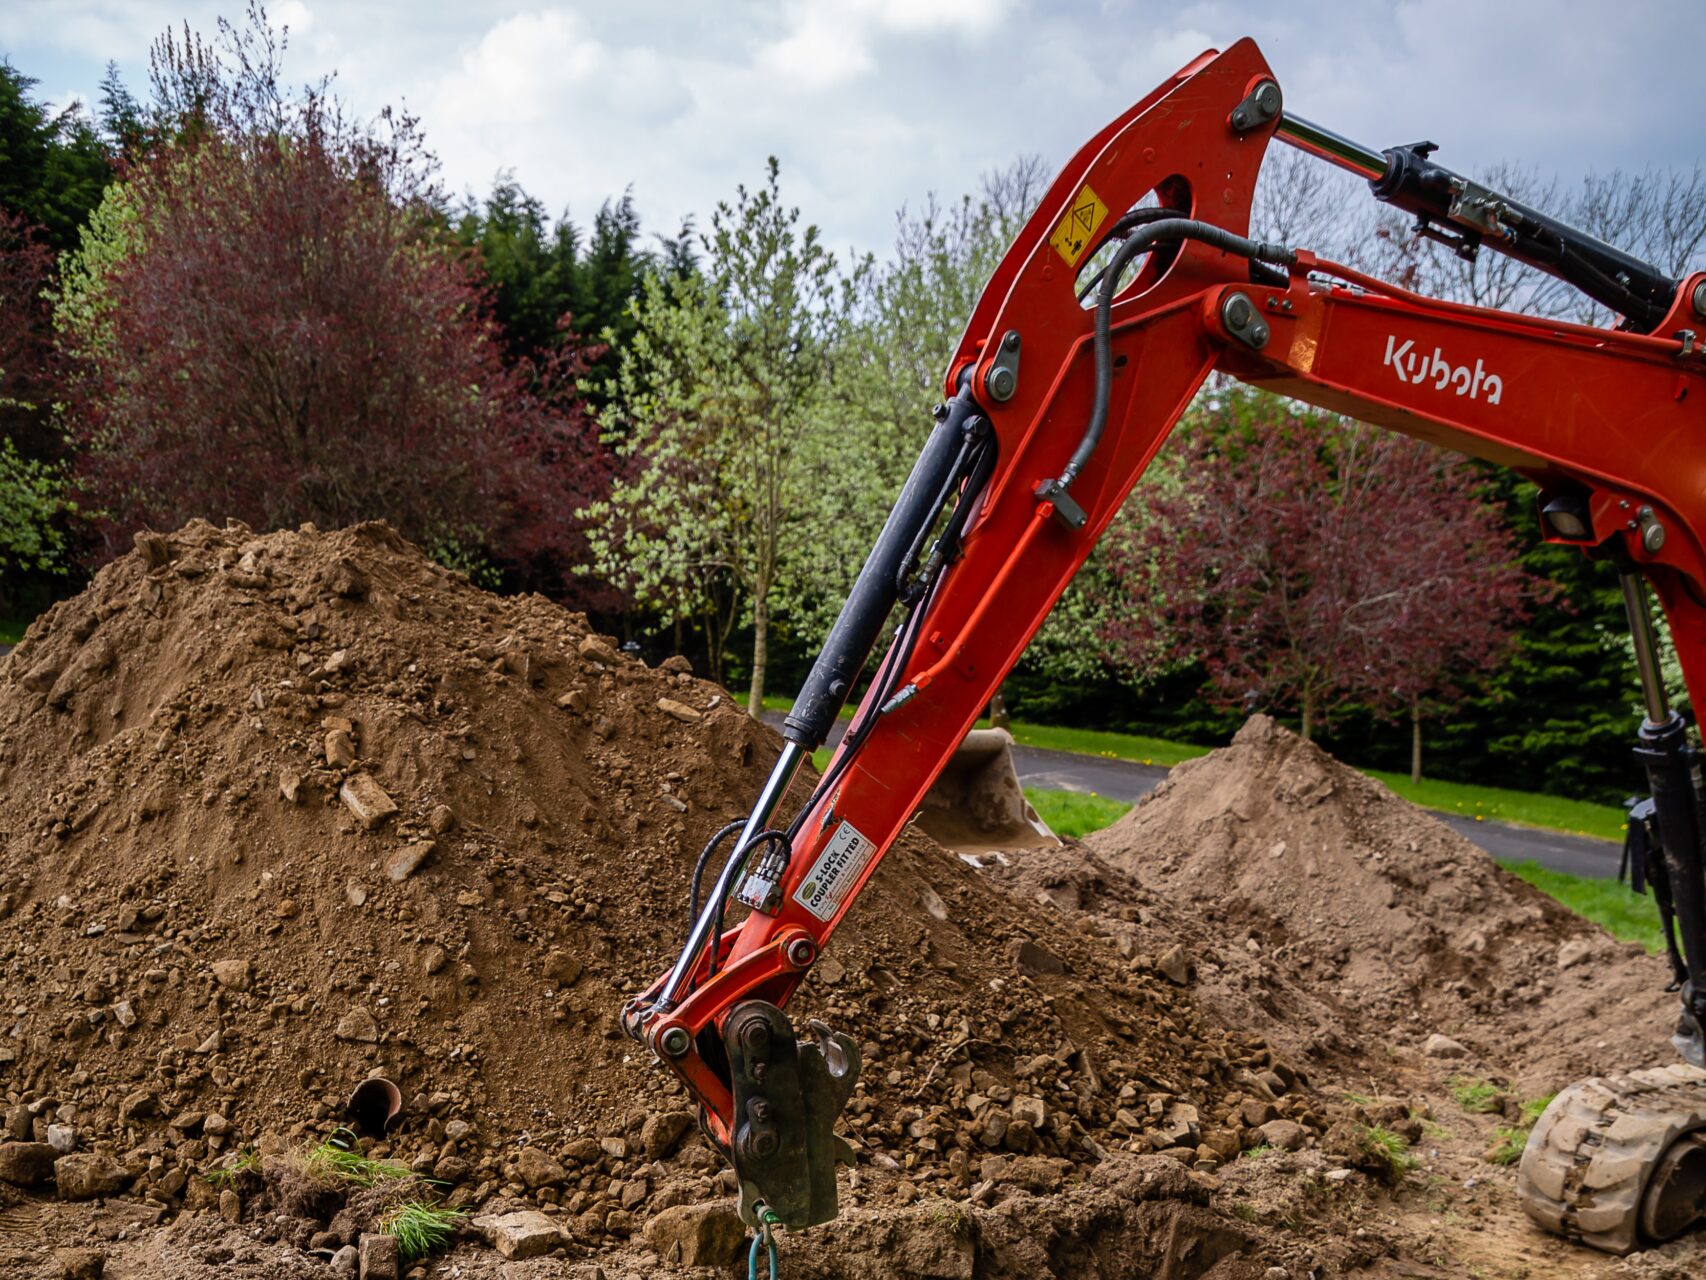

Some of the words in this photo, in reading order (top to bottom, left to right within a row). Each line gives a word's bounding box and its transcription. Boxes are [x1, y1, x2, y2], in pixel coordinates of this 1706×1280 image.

[1383, 335, 1503, 405] Kubota
[810, 866, 840, 908] COUPLER
[836, 837, 860, 868] FITTED
[815, 849, 840, 883] S-LOCK
